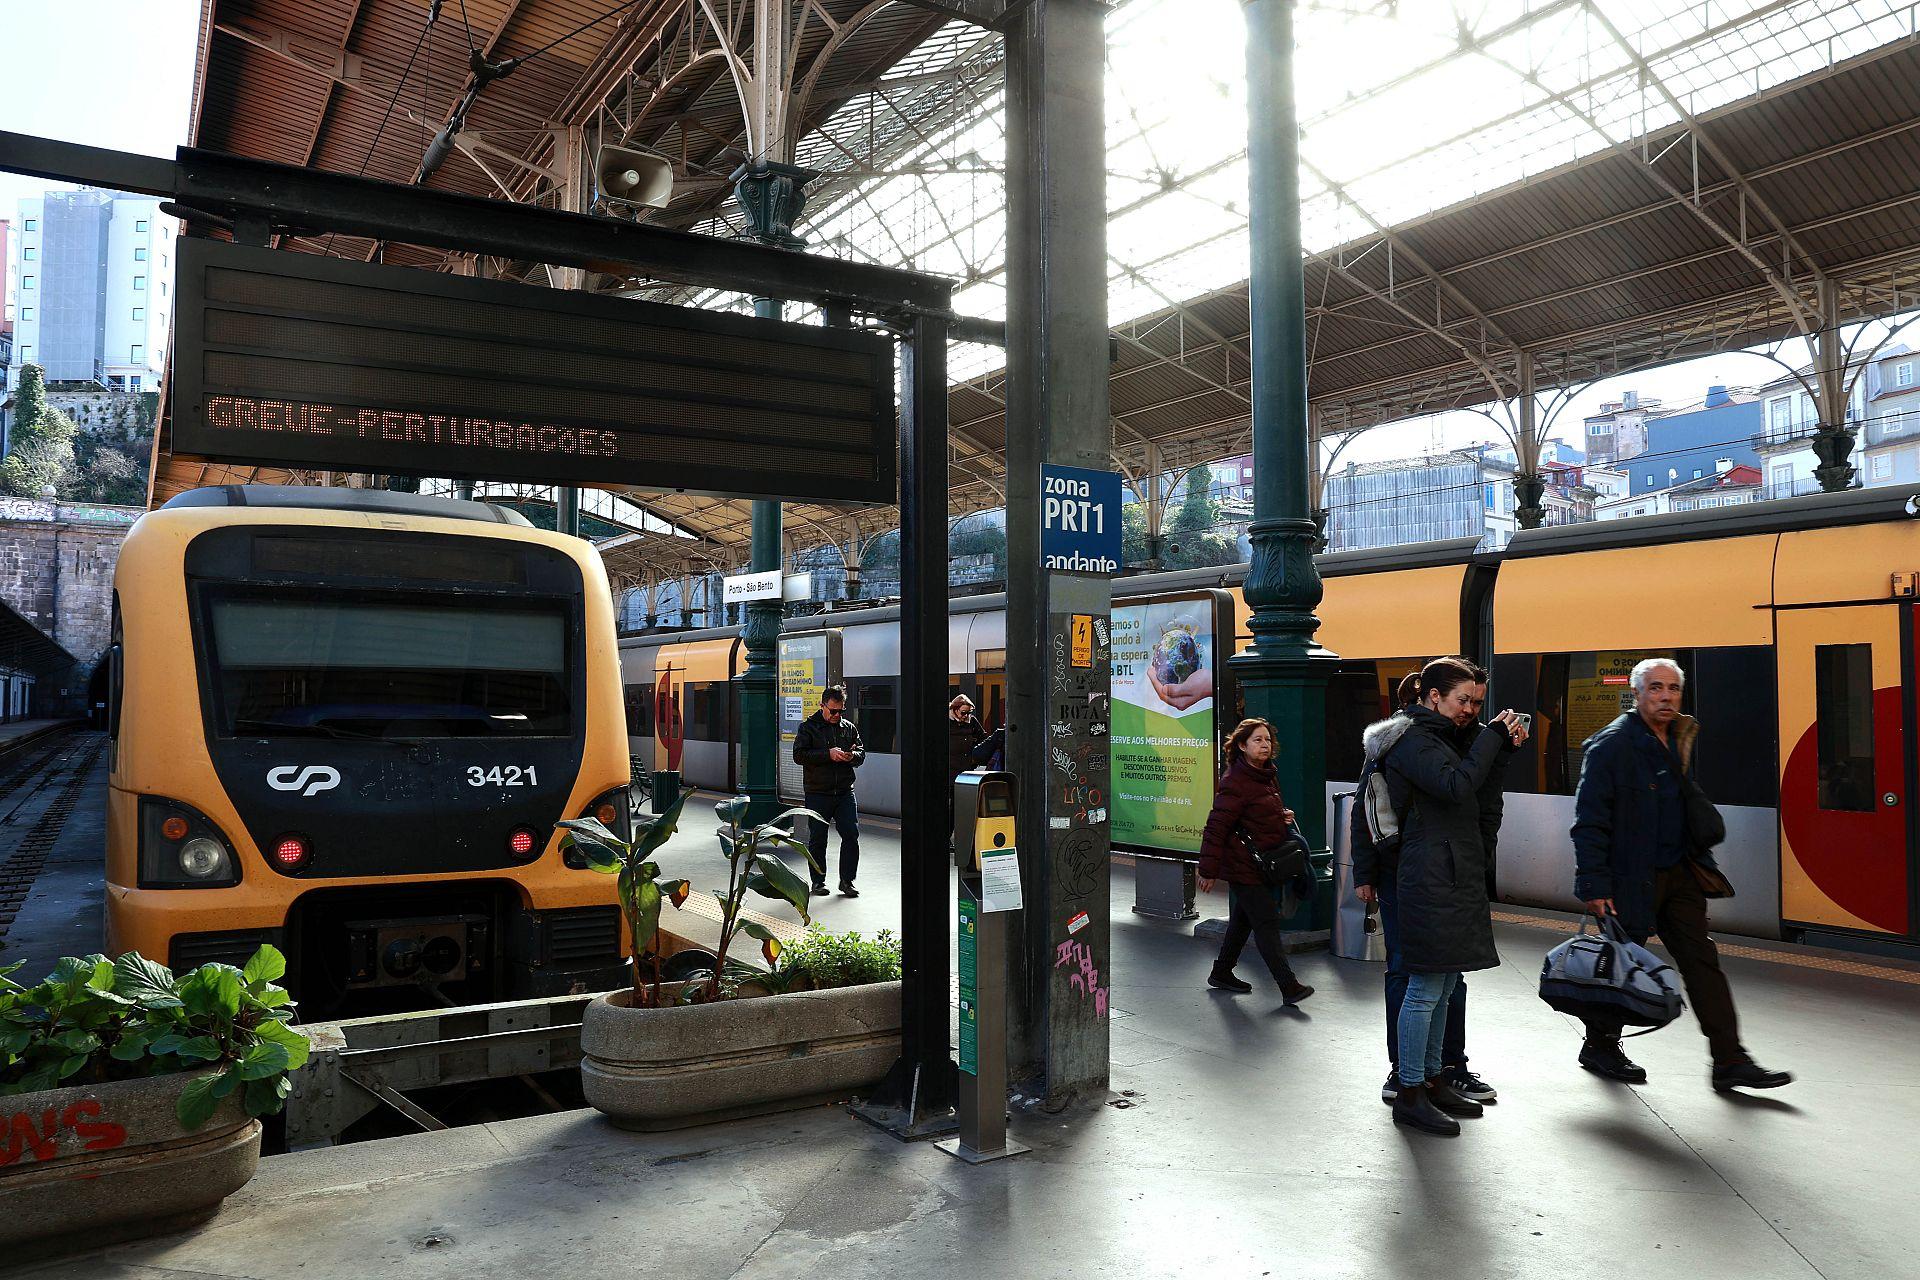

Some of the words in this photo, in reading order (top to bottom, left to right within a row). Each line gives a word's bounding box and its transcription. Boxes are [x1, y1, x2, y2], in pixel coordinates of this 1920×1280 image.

[1045, 476, 1090, 498] zona
[1044, 497, 1103, 534] PRT1
[1045, 550, 1117, 573] andante
[728, 584, 743, 595] Porto
[746, 582, 757, 593] São
[757, 581, 774, 592] Bento
[1110, 619, 1132, 630] emos
[1133, 619, 1140, 629] o
[1112, 633, 1133, 646] undo
[1135, 633, 1141, 644] à
[1120, 650, 1149, 663] espera
[1116, 664, 1134, 676] BTL
[1110, 735, 1131, 745] ESERVE
[1131, 736, 1145, 745] AOS
[1145, 736, 1182, 747] MELHORES
[1182, 738, 1209, 749] PREÇOS
[1115, 753, 1145, 762] HABILITE-SE
[1148, 755, 1172, 763] GANHAR
[1123, 763, 1155, 772] DESCONTOS
[1154, 765, 1188, 774] EXCLUSIVOS
[466, 765, 538, 787] 3421
[1124, 772, 1144, 780] MUITOS
[1145, 773, 1167, 782] OUTROS
[1151, 824, 1175, 832] VIAGENS
